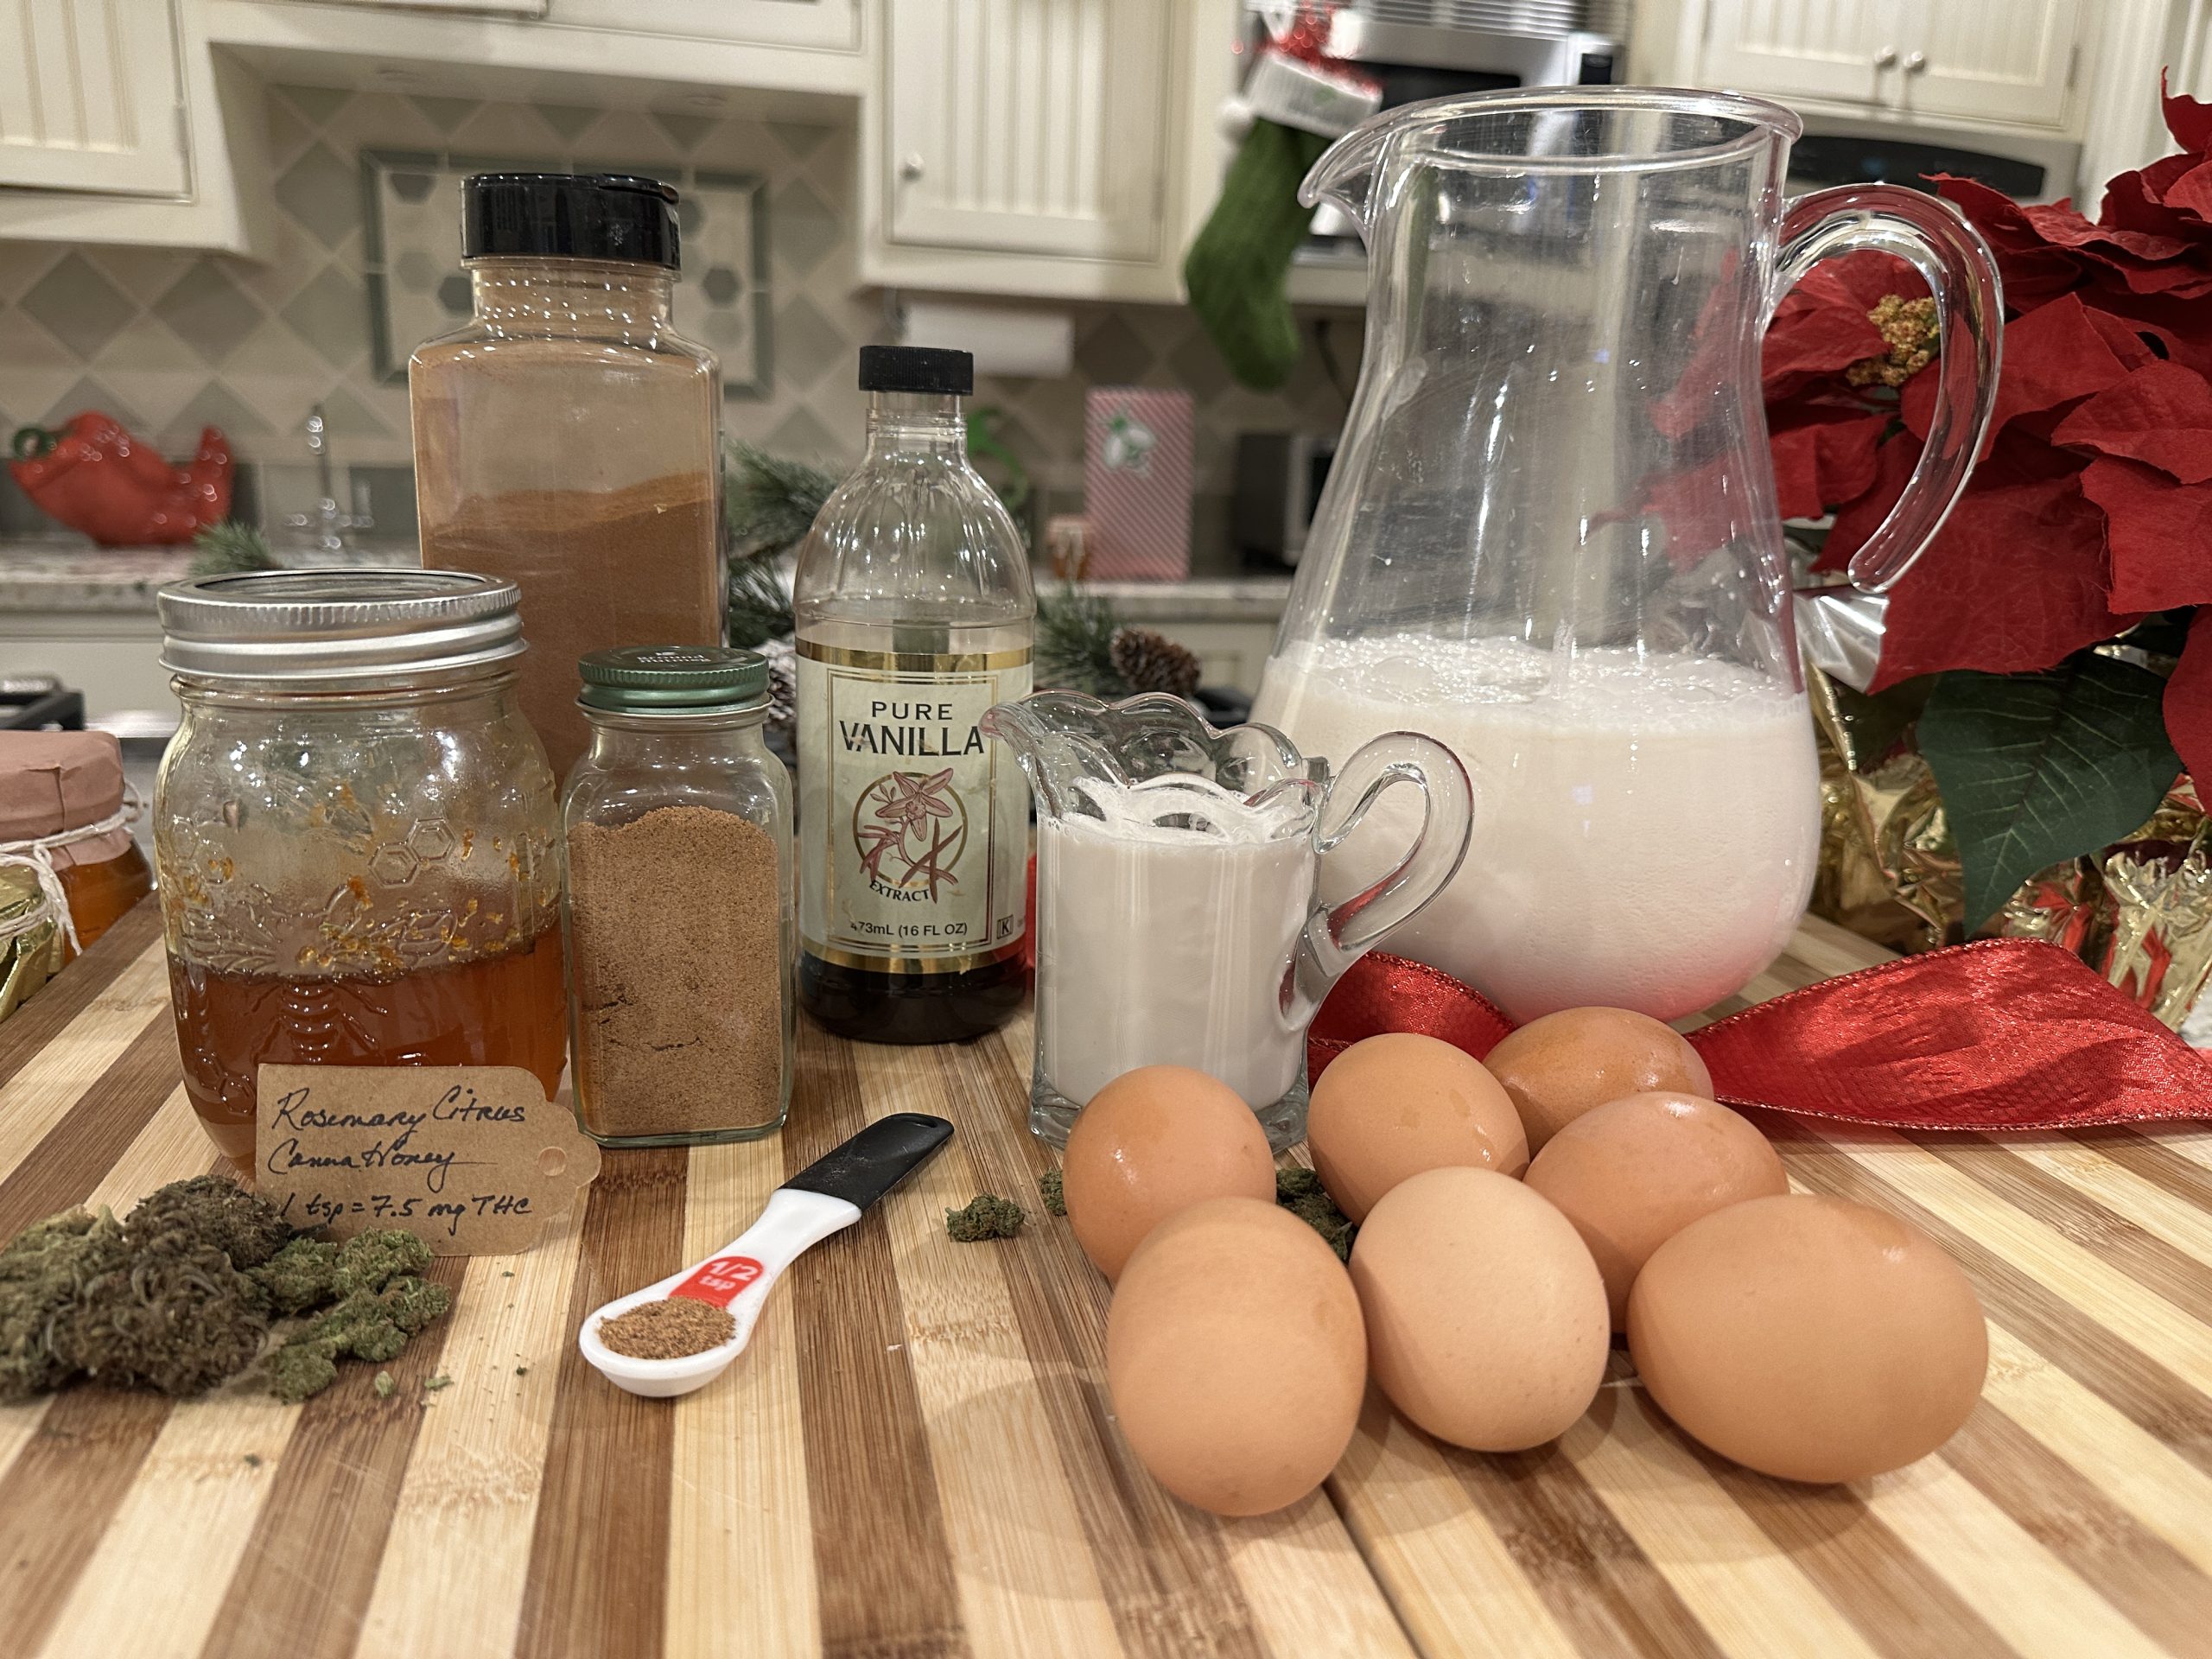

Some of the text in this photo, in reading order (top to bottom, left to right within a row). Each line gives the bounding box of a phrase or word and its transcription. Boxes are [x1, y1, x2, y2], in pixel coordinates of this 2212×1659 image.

[871, 701, 953, 721] PURE
[839, 720, 985, 756] VANILLA
[868, 880, 930, 902] EXTRACT
[898, 925, 919, 938] (16
[924, 925, 941, 936] FL
[944, 922, 969, 937] OZ)
[272, 1085, 526, 1141] Rosemary Citrus
[428, 1202, 467, 1236] mg
[472, 1194, 533, 1216] THC
[710, 1262, 758, 1281] 1/2
[699, 1275, 735, 1290] tsp
